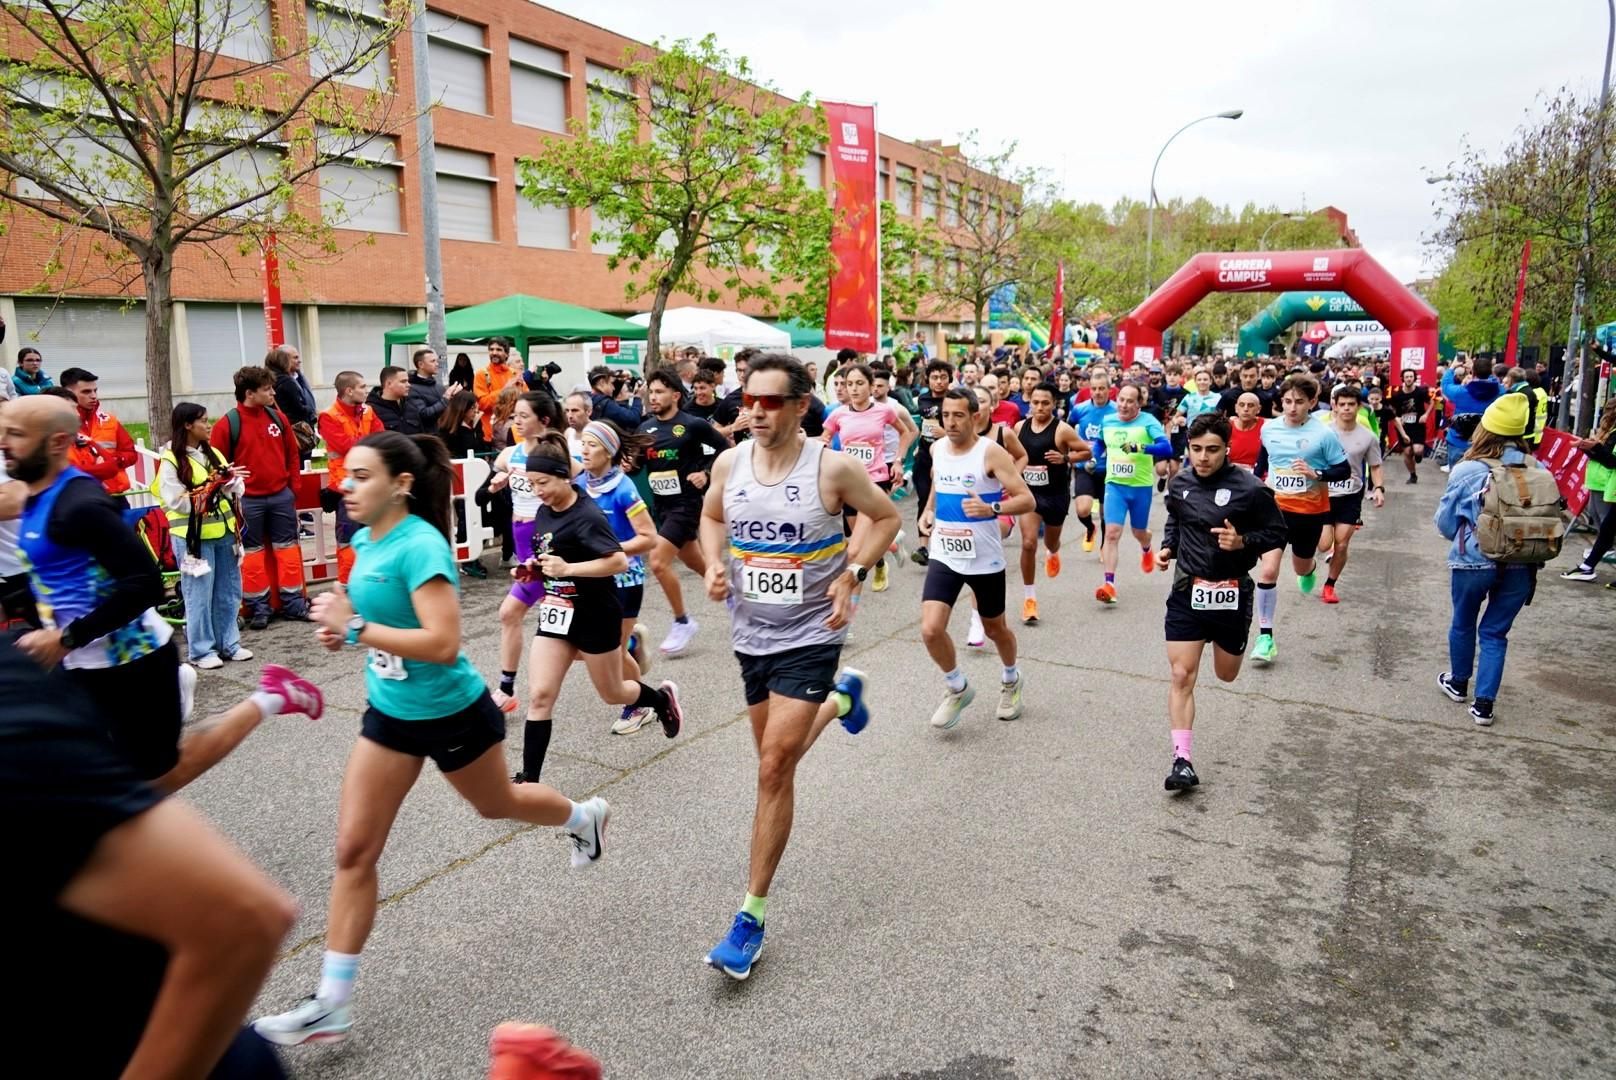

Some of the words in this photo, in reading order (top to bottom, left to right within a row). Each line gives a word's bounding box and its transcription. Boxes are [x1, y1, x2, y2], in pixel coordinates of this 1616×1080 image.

[1219, 259, 1272, 271] CARRERA
[1218, 271, 1266, 282] CAMPUS
[1329, 304, 1341, 312] DE
[1335, 324, 1351, 332] LA
[1112, 464, 1133, 473] 1060
[651, 479, 678, 490] 2023
[1275, 476, 1304, 487] 2075
[940, 538, 972, 552] 1580
[747, 571, 798, 594] 1684
[1195, 588, 1236, 604] 3108
